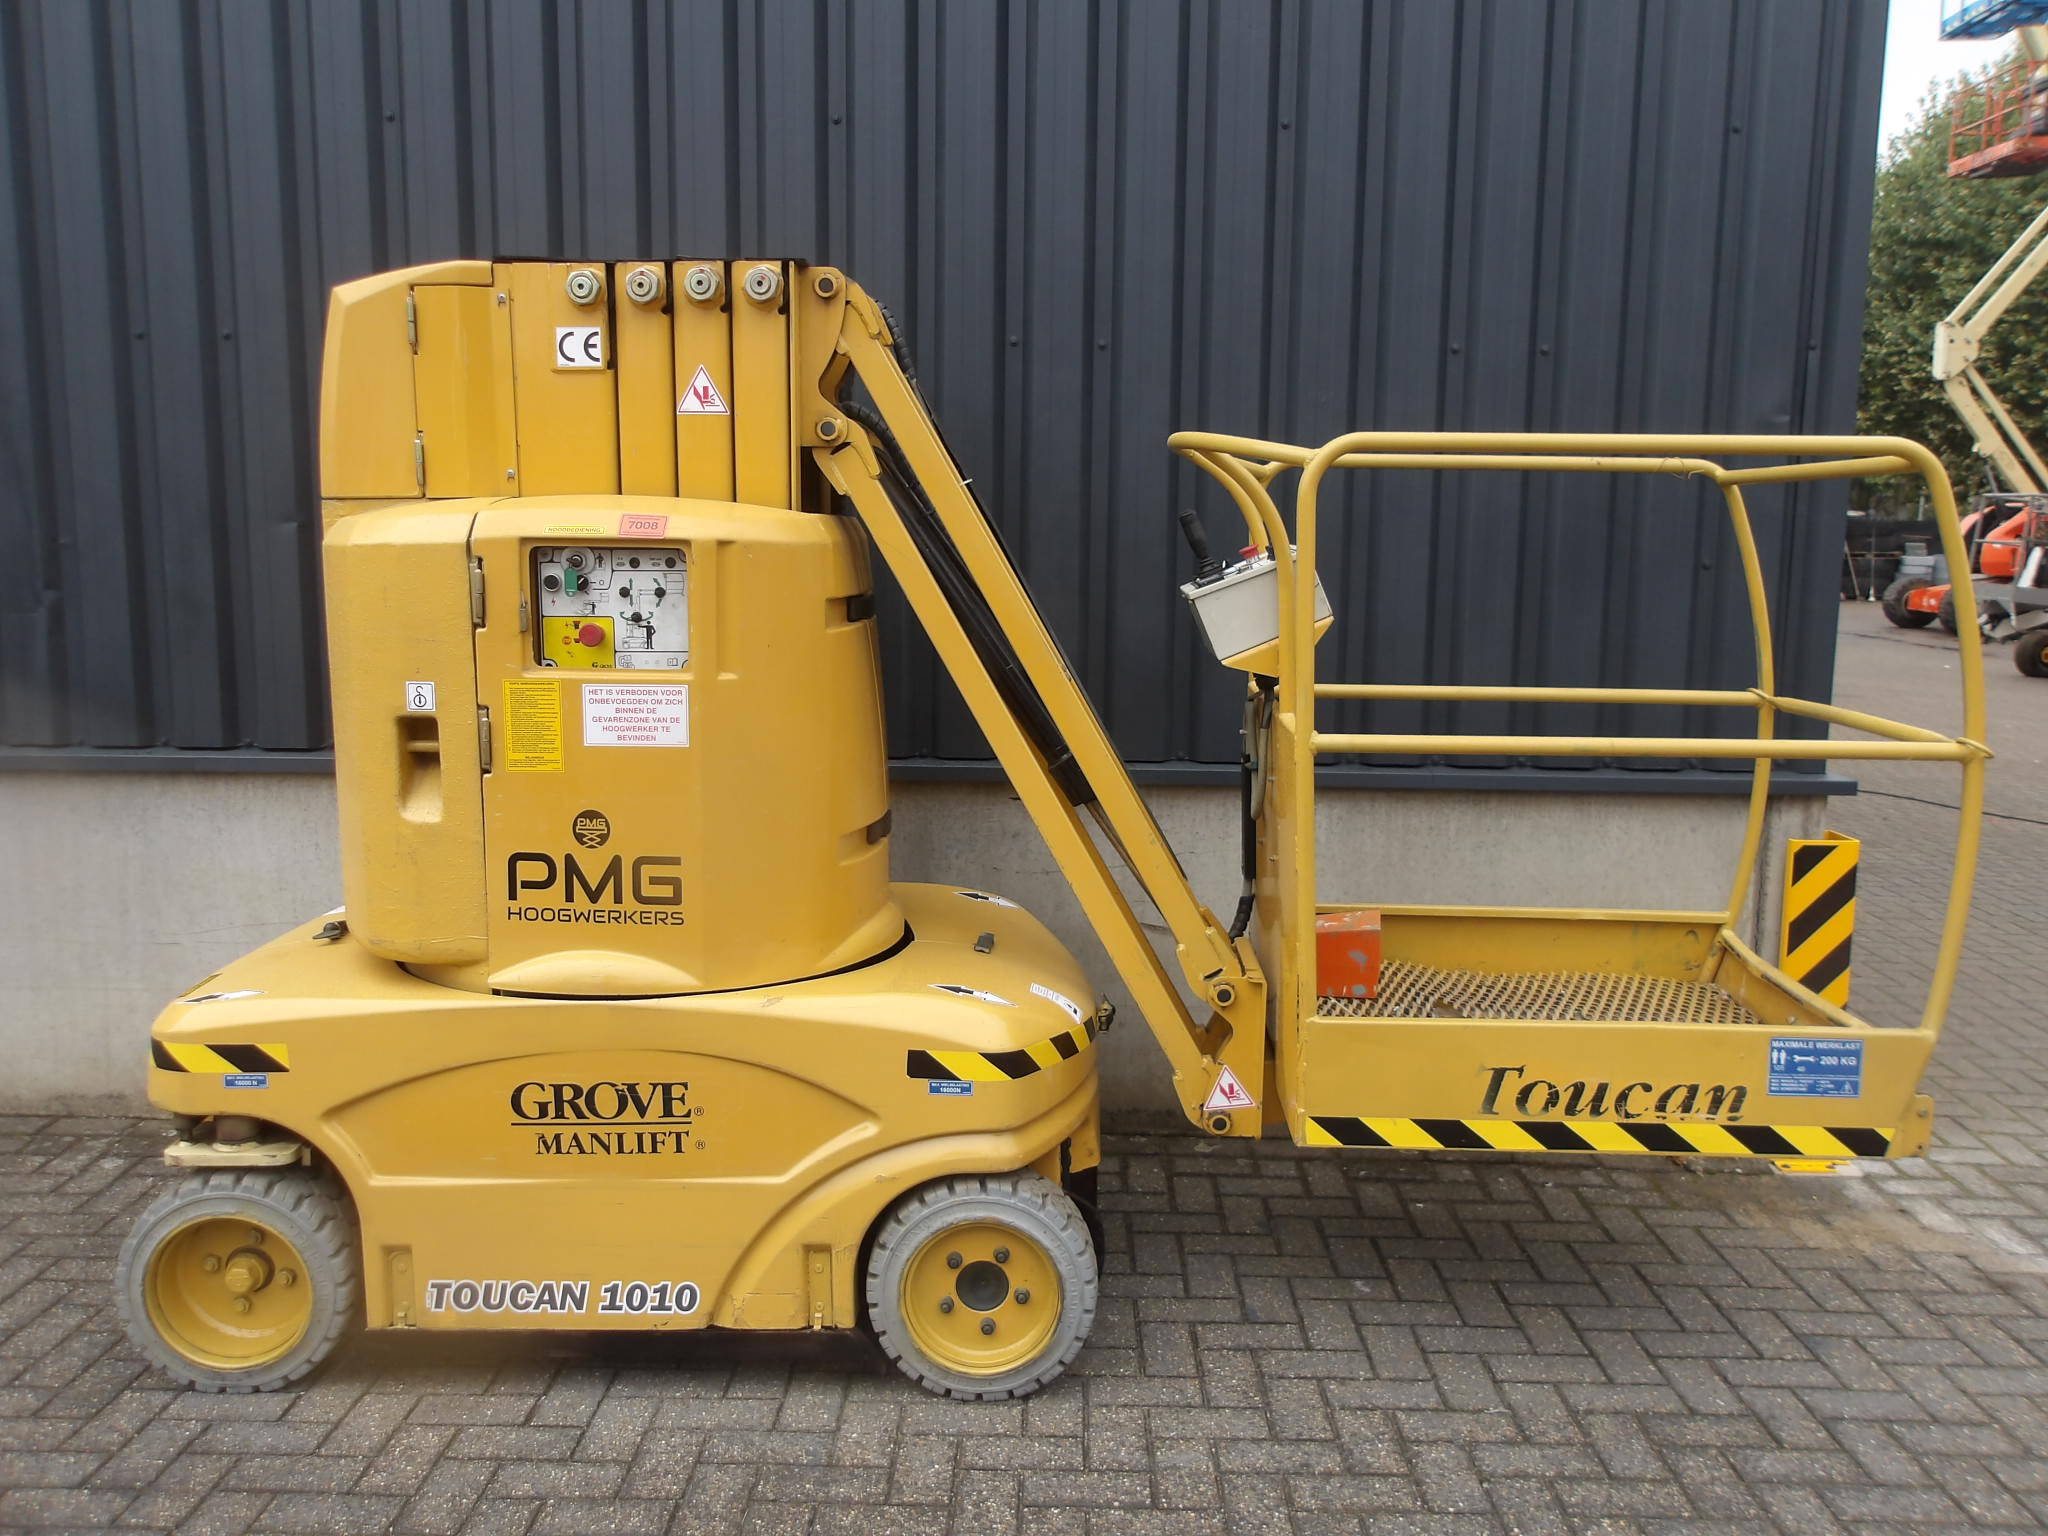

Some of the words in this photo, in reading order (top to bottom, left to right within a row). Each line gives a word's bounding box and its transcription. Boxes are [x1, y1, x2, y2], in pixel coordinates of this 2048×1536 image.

[558, 331, 601, 363] CE
[628, 520, 658, 530] 7008
[588, 697, 649, 705] ONBEVOEGDEN
[660, 725, 671, 733] TE
[577, 817, 606, 828] PMG
[508, 852, 682, 905] PMG
[508, 906, 684, 926] HOOGWERKERS
[1771, 1040, 1814, 1049] MAXIMALE
[1815, 1041, 1860, 1049] WERKLAST
[1820, 1055, 1839, 1065] 200
[1840, 1056, 1857, 1066] KG
[510, 1081, 692, 1120] GROVE
[1478, 1064, 1749, 1122] Toucan
[535, 1130, 690, 1156] MANLIFT
[429, 1280, 590, 1313] TOUCAN
[599, 1281, 700, 1314] 1010
